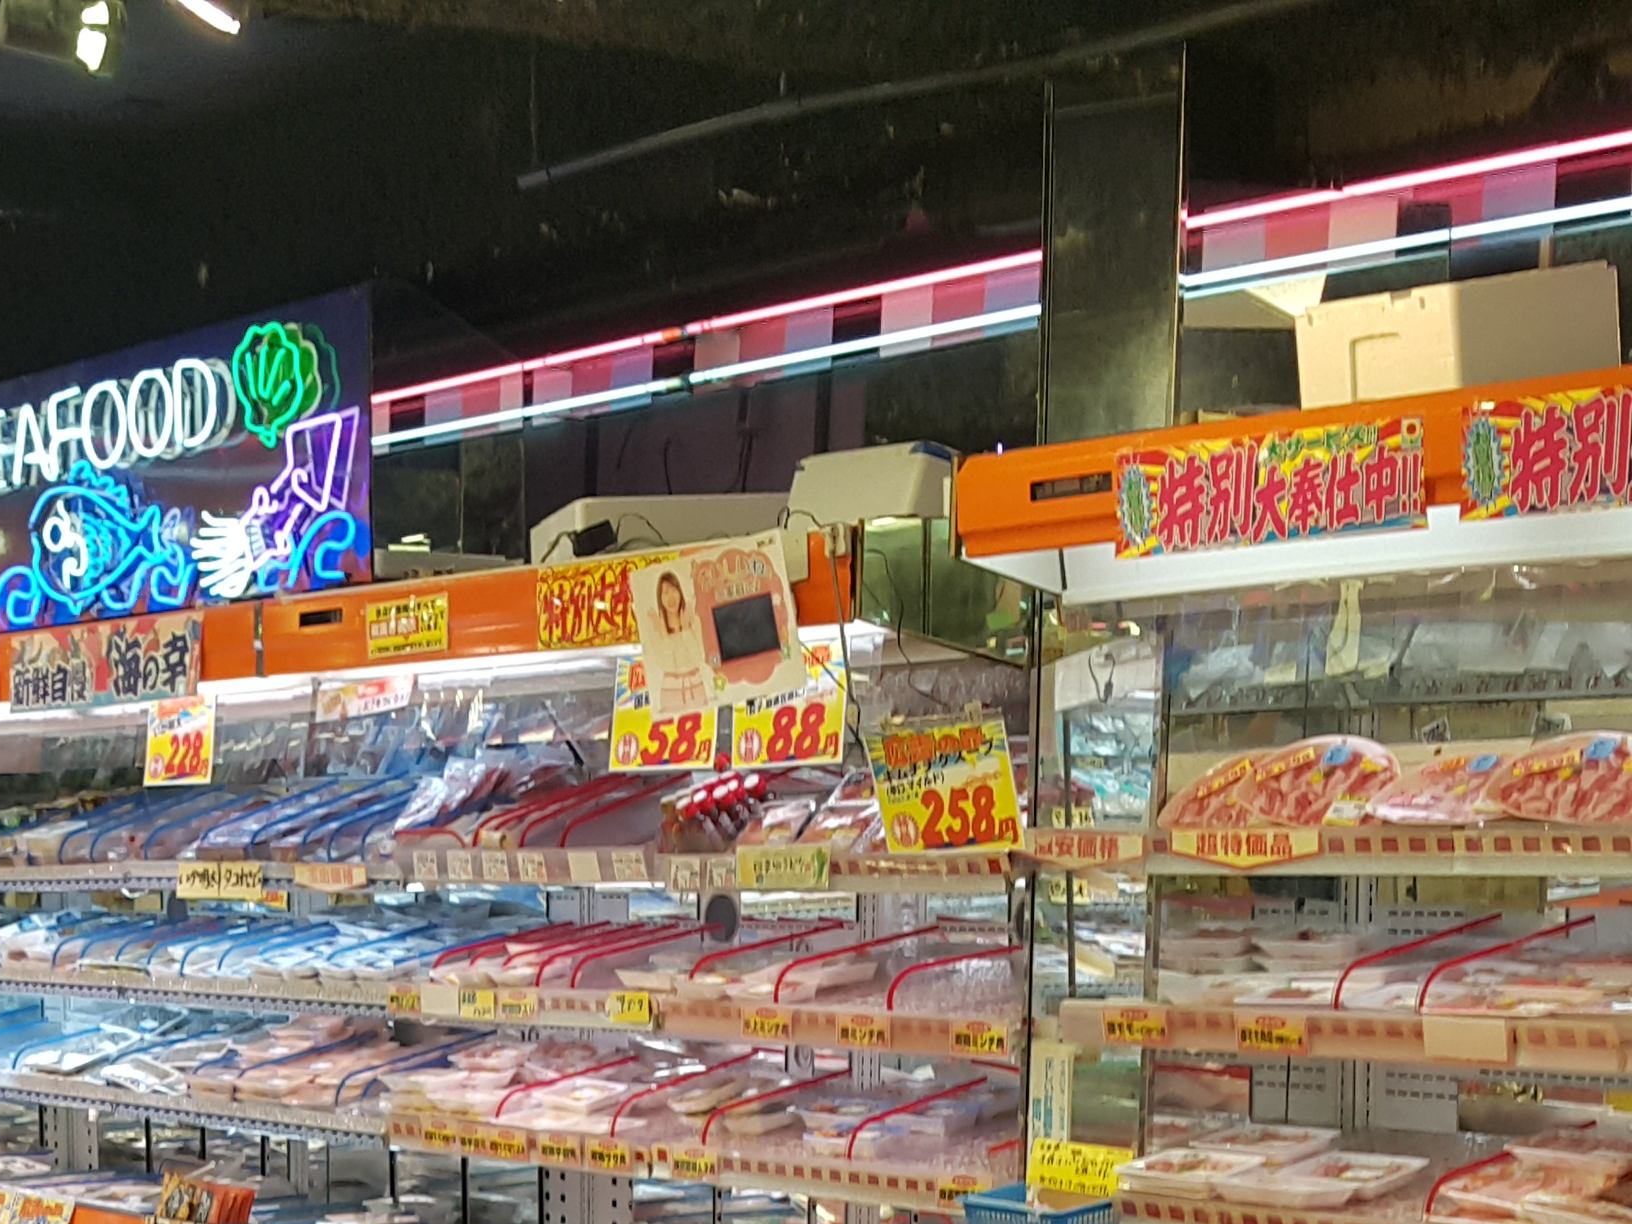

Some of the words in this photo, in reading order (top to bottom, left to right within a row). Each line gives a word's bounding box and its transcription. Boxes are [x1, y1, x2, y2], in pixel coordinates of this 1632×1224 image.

[110, 627, 190, 700] 海の幸
[767, 703, 839, 763] 88円
[921, 785, 1019, 849] 258円
